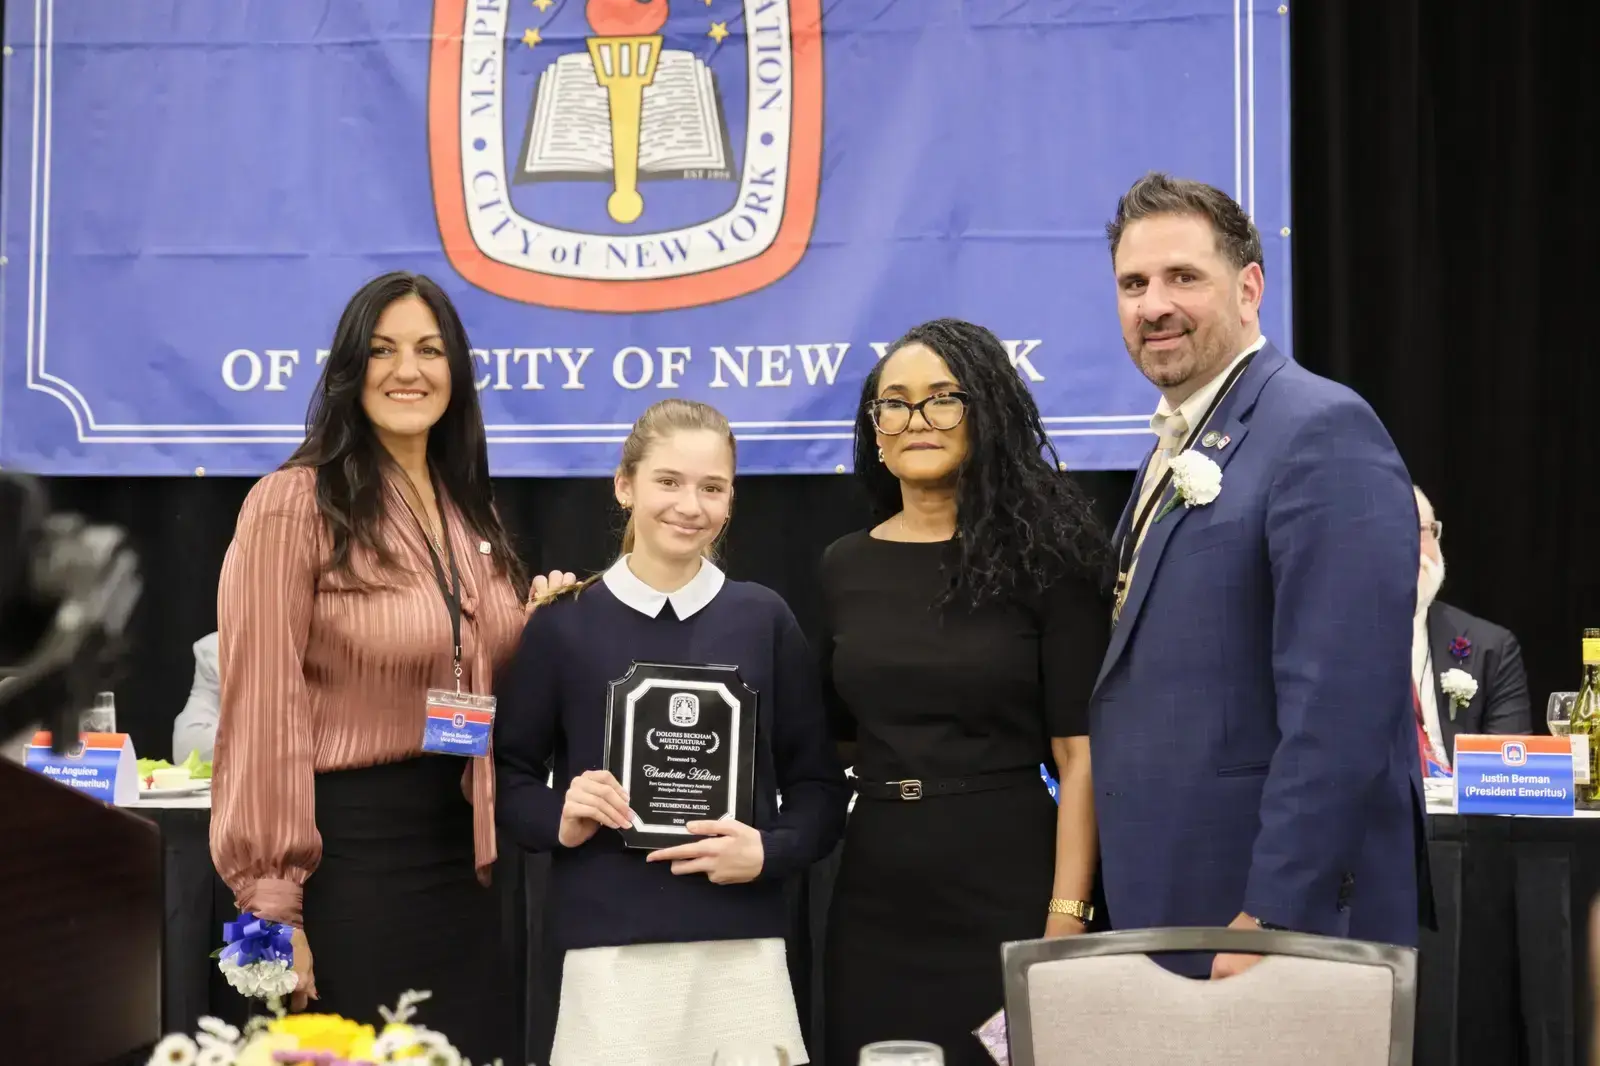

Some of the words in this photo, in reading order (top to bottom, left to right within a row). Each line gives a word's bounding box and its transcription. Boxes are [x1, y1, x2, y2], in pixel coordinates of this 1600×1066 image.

[470, 50, 497, 117] M.S.
[473, 170, 542, 257] CITY
[551, 241, 587, 265] of
[604, 234, 691, 269] NEW
[705, 163, 777, 252] YORK
[221, 348, 299, 391] OF
[612, 345, 692, 389] OF
[708, 342, 851, 388] NEW
[659, 737, 706, 746] MULTICULTURAL
[683, 732, 712, 740] BECKHAM
[43, 765, 61, 774] Alex
[642, 764, 686, 779] Charlotte
[71, 778, 110, 790] Emeritus)
[1480, 773, 1510, 783] Justin
[1511, 774, 1550, 784] Berman
[1465, 786, 1516, 797] (President
[1518, 787, 1567, 799] Emeritus)
[649, 802, 691, 810] INSTRUMENTAL
